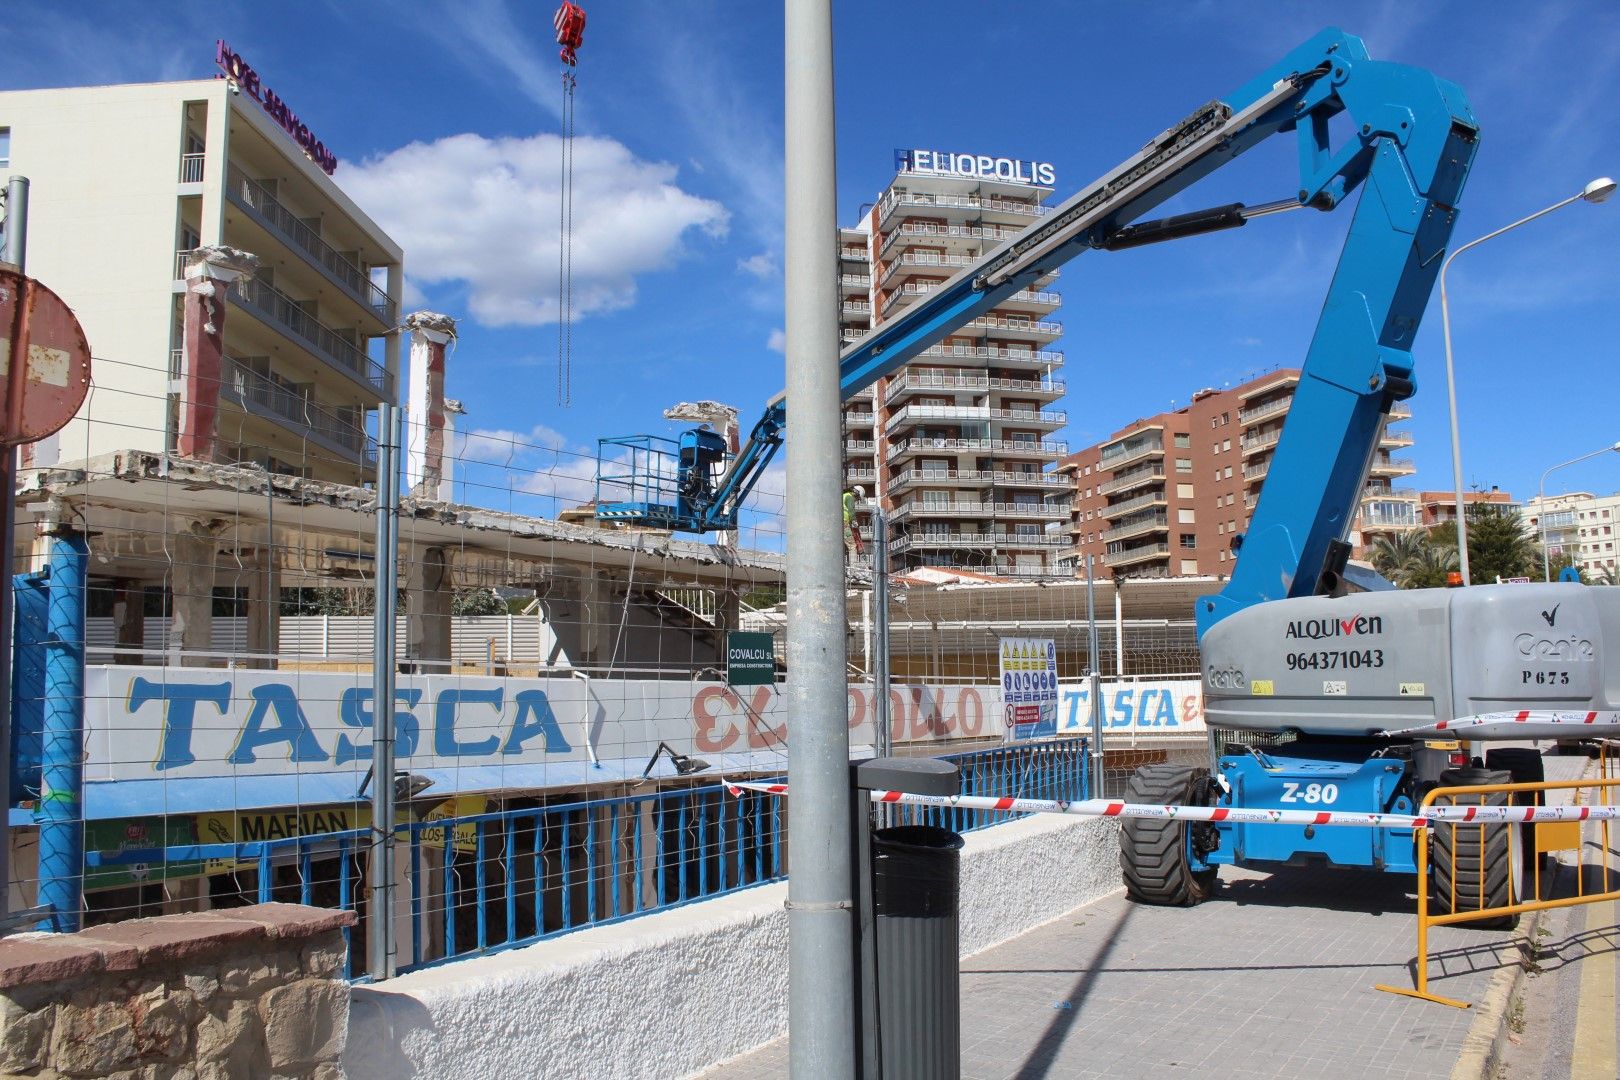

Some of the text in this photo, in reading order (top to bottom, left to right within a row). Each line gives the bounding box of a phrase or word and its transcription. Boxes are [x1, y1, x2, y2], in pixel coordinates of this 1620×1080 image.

[894, 148, 1056, 185] HELIOPOLIS
[729, 648, 765, 660] COVALCU
[1286, 650, 1385, 671] 964371043
[1513, 632, 1595, 663] Genie
[1207, 664, 1245, 689] Genie
[1182, 695, 1205, 722] E
[125, 676, 572, 772] TASCA
[1280, 782, 1339, 805] Z-80
[241, 810, 349, 842] MARIAN
